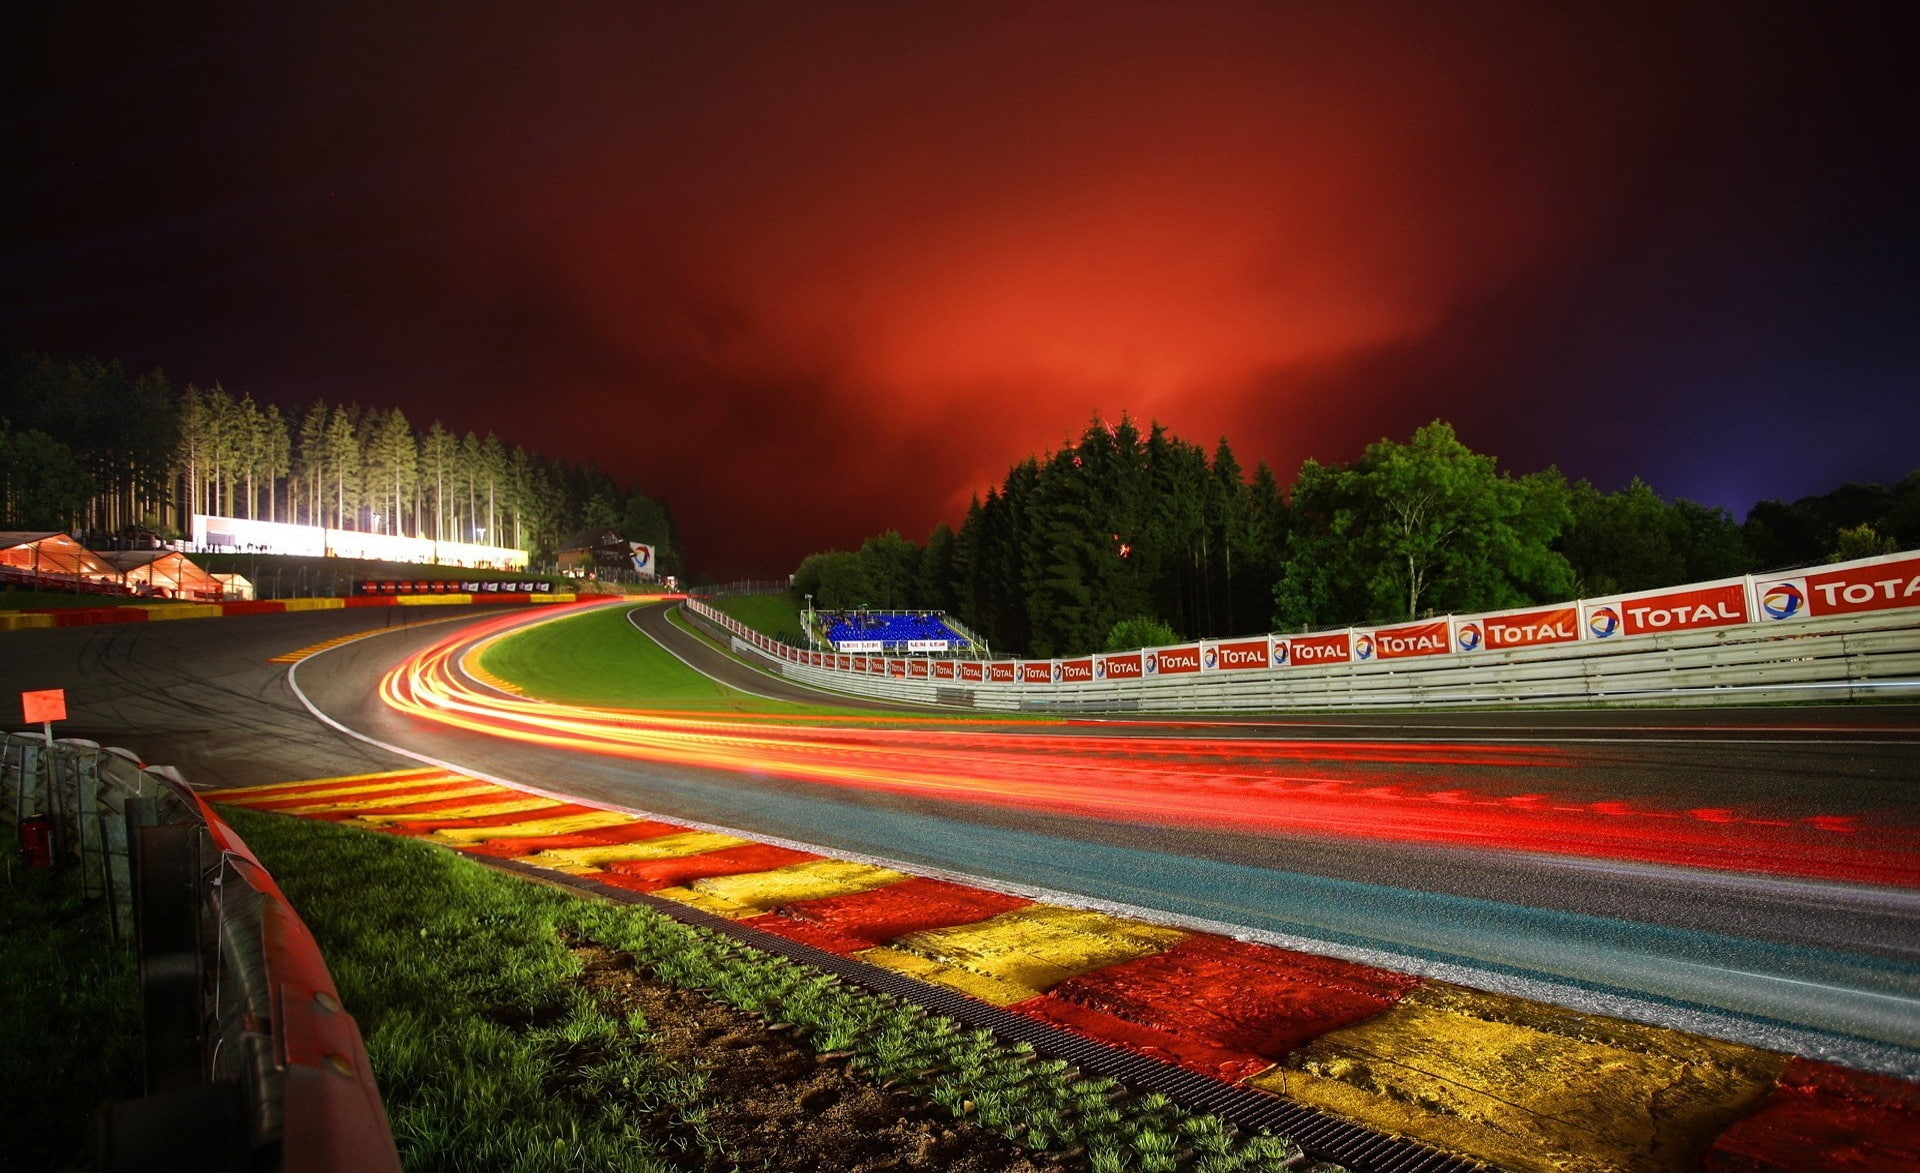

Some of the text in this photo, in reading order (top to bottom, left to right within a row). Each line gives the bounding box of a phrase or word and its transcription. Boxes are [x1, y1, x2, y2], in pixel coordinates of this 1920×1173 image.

[1627, 602, 1740, 629] TOTAL
[1488, 622, 1574, 644] TOTAL
[1379, 633, 1445, 653] TOTAL
[1221, 649, 1266, 664] TOTAL
[1293, 644, 1347, 659] TOTAL
[1108, 661, 1140, 673] TOTAL
[1160, 655, 1198, 668] TOTAL
[891, 663, 905, 672] TOTAL
[912, 663, 928, 673] TOTAL
[936, 665, 953, 675] TOTAL
[963, 666, 981, 677] TOTAL
[993, 667, 1013, 677] TOTAL
[1026, 667, 1049, 678] TOTAL
[1063, 666, 1091, 677] TOTAL
